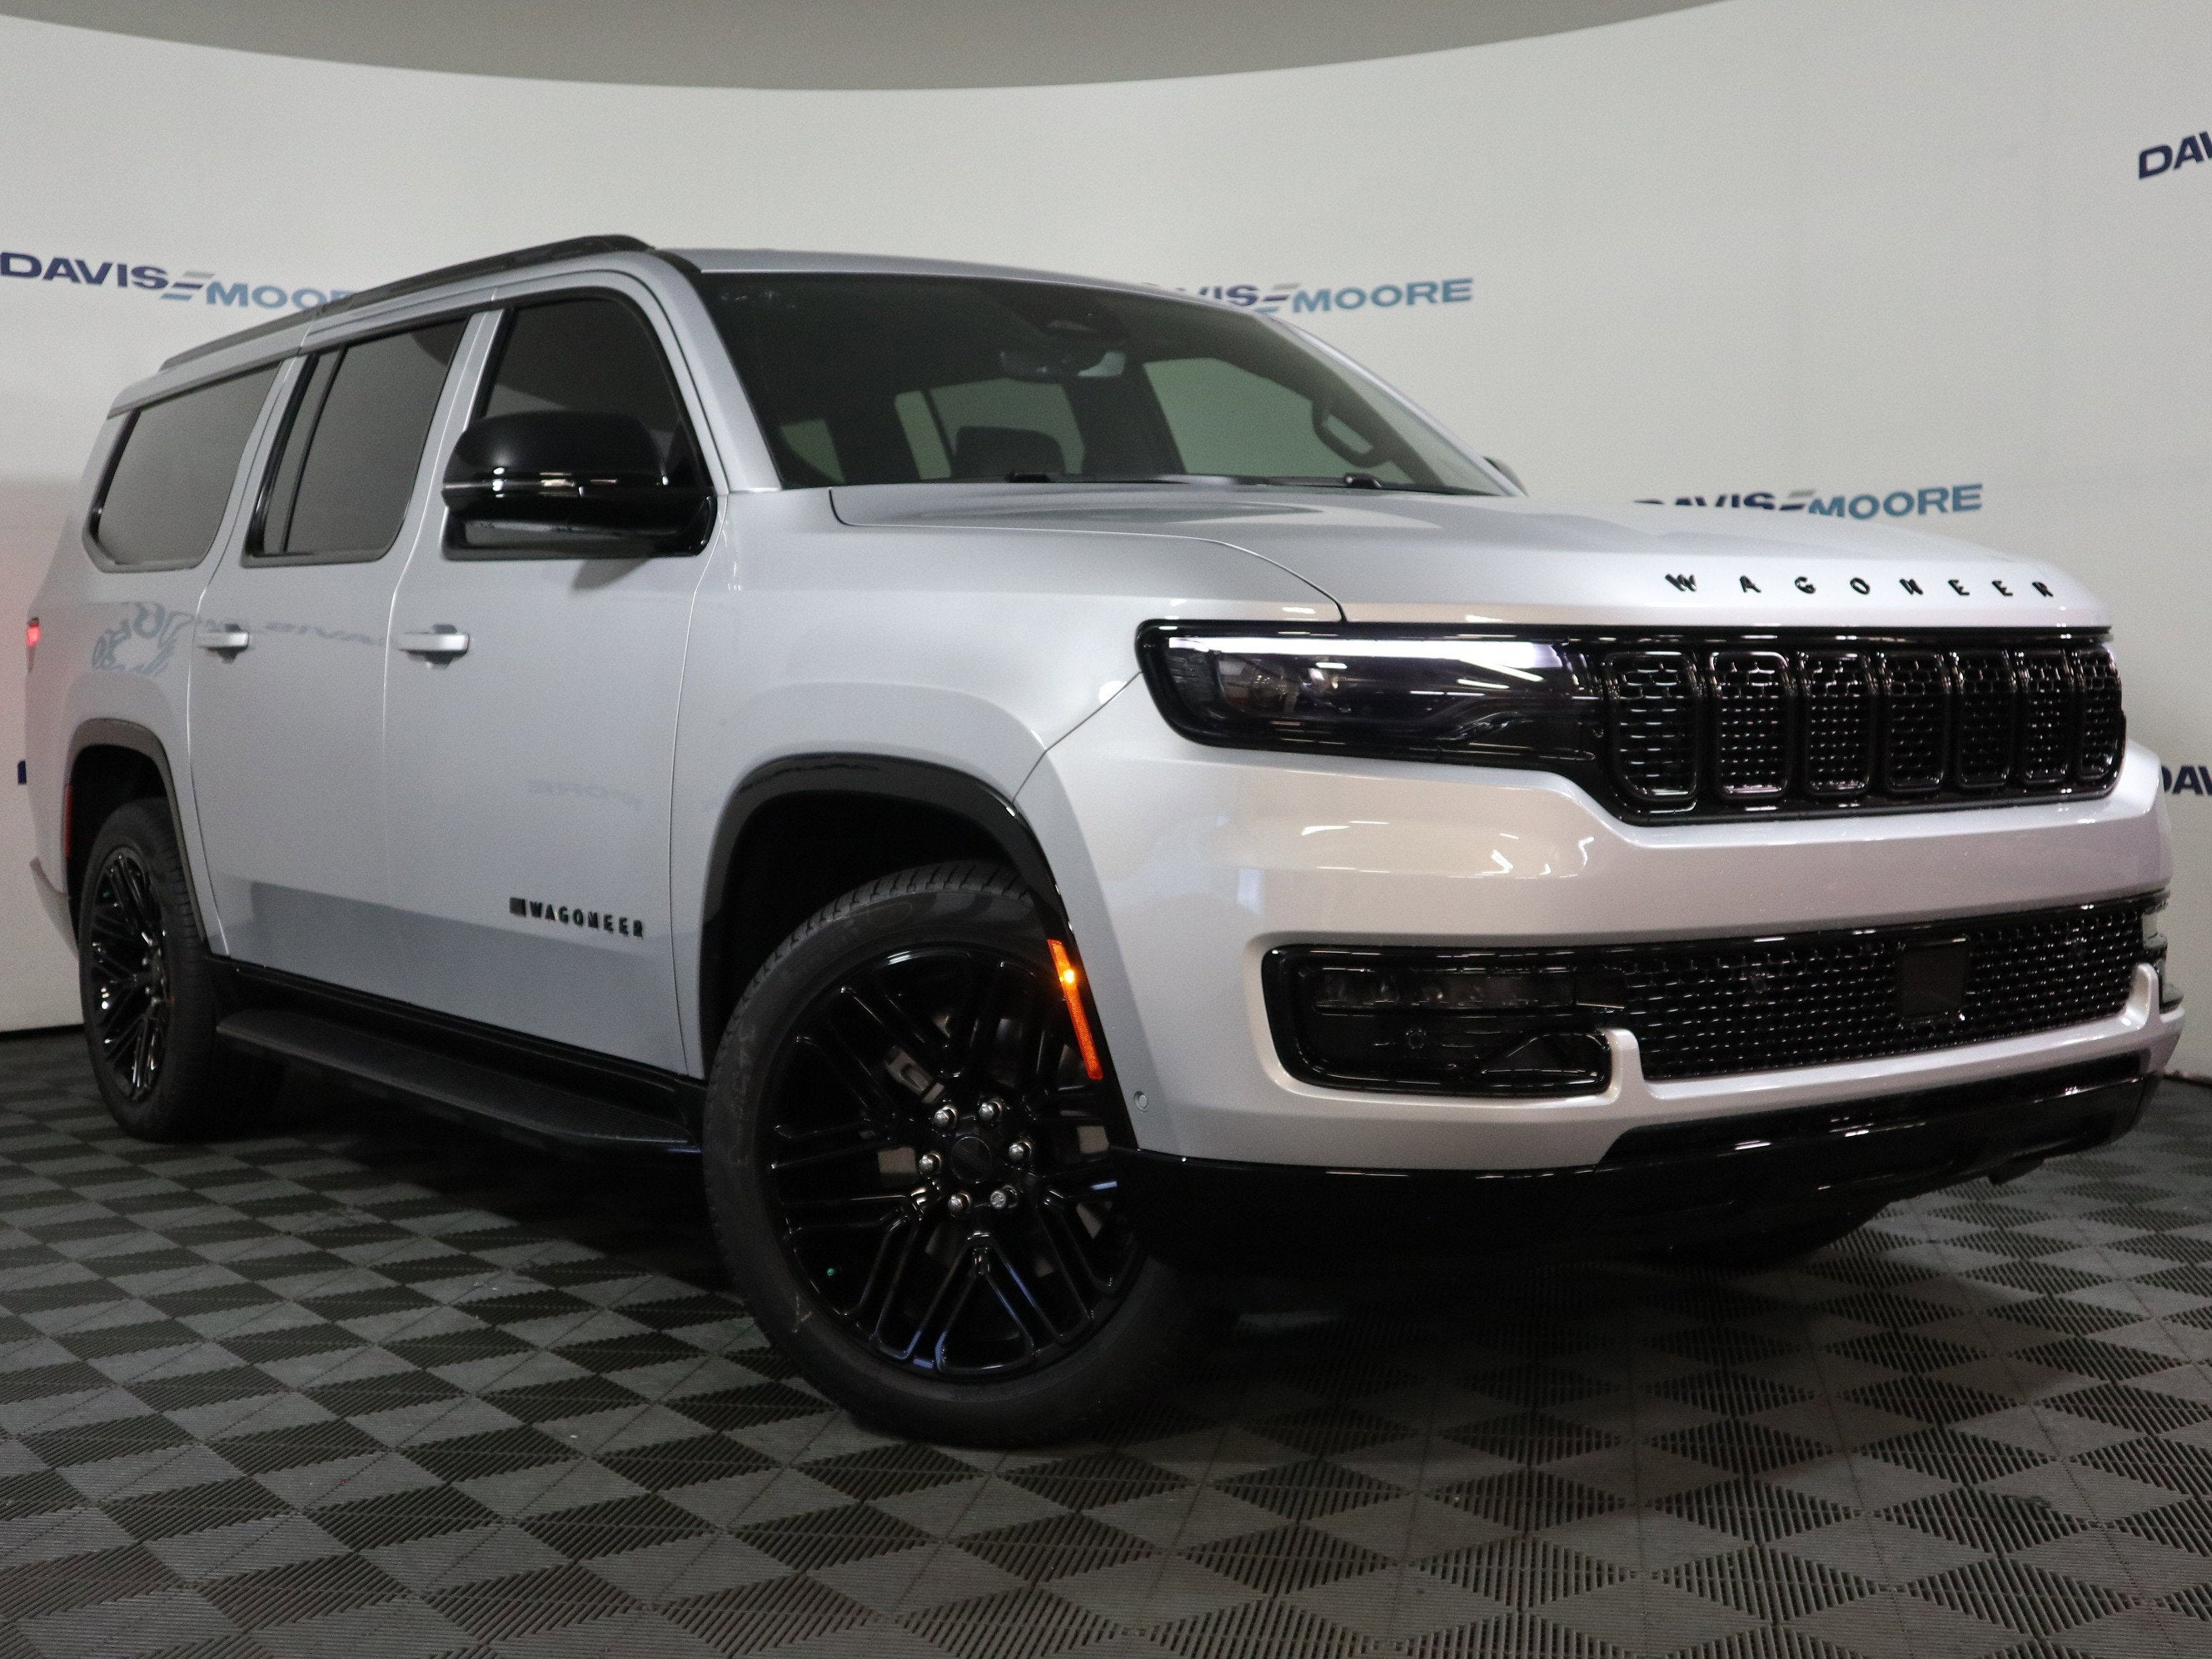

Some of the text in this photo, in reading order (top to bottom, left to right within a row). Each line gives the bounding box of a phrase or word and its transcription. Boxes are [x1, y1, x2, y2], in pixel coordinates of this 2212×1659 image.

[0, 252, 169, 291] DAVIS
[1293, 277, 1474, 314] MOORE
[1807, 483, 1983, 521] MOORE
[1664, 572, 2055, 598] WAGONEER
[528, 899, 645, 939] WAGONEER
